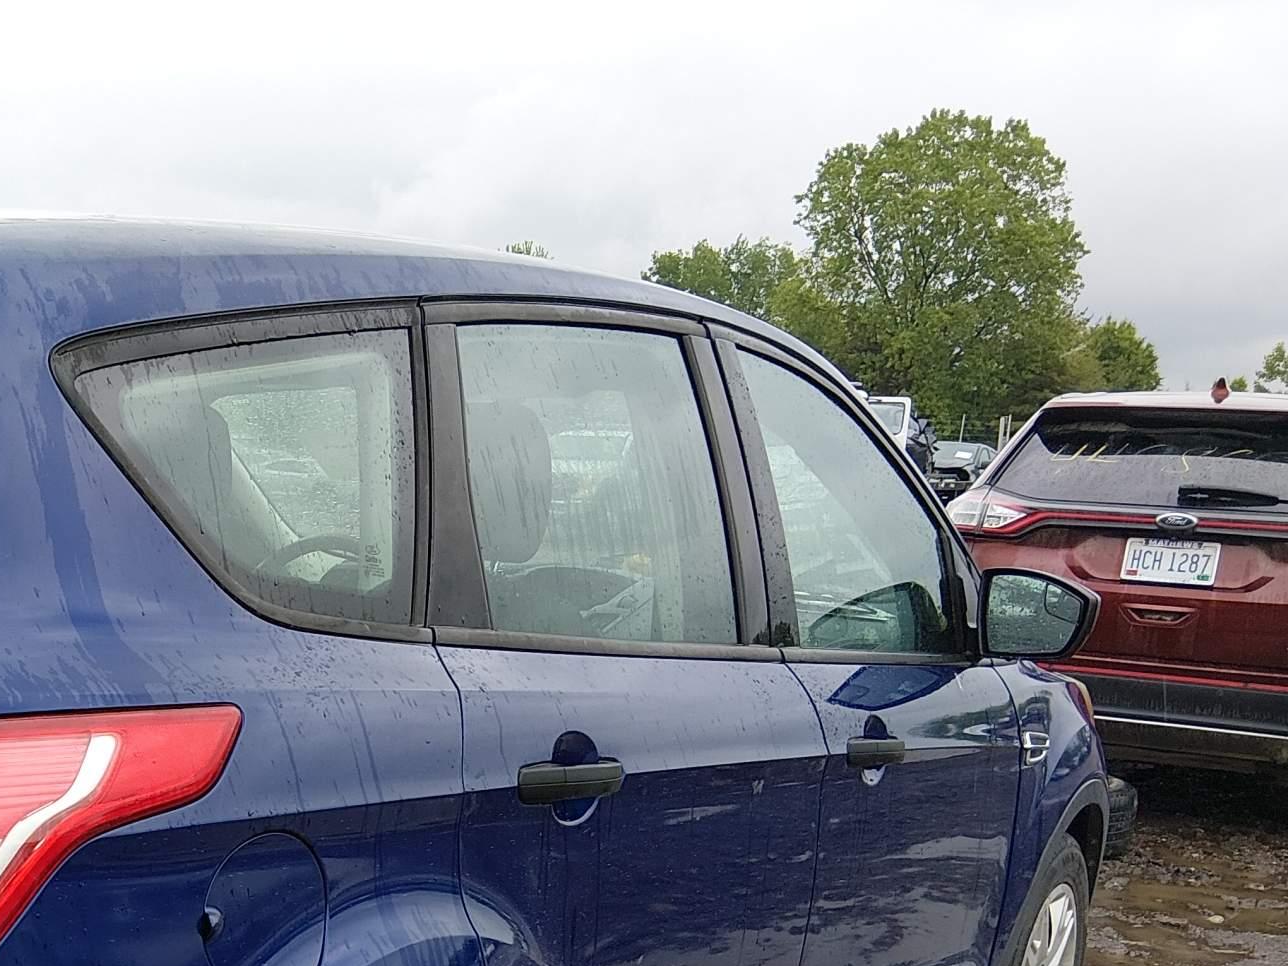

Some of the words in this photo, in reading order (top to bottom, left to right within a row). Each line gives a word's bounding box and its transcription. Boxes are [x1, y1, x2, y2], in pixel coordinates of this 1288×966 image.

[1165, 515, 1189, 527] Ford
[1130, 548, 1164, 572] HCH
[1167, 551, 1212, 576] 1287
